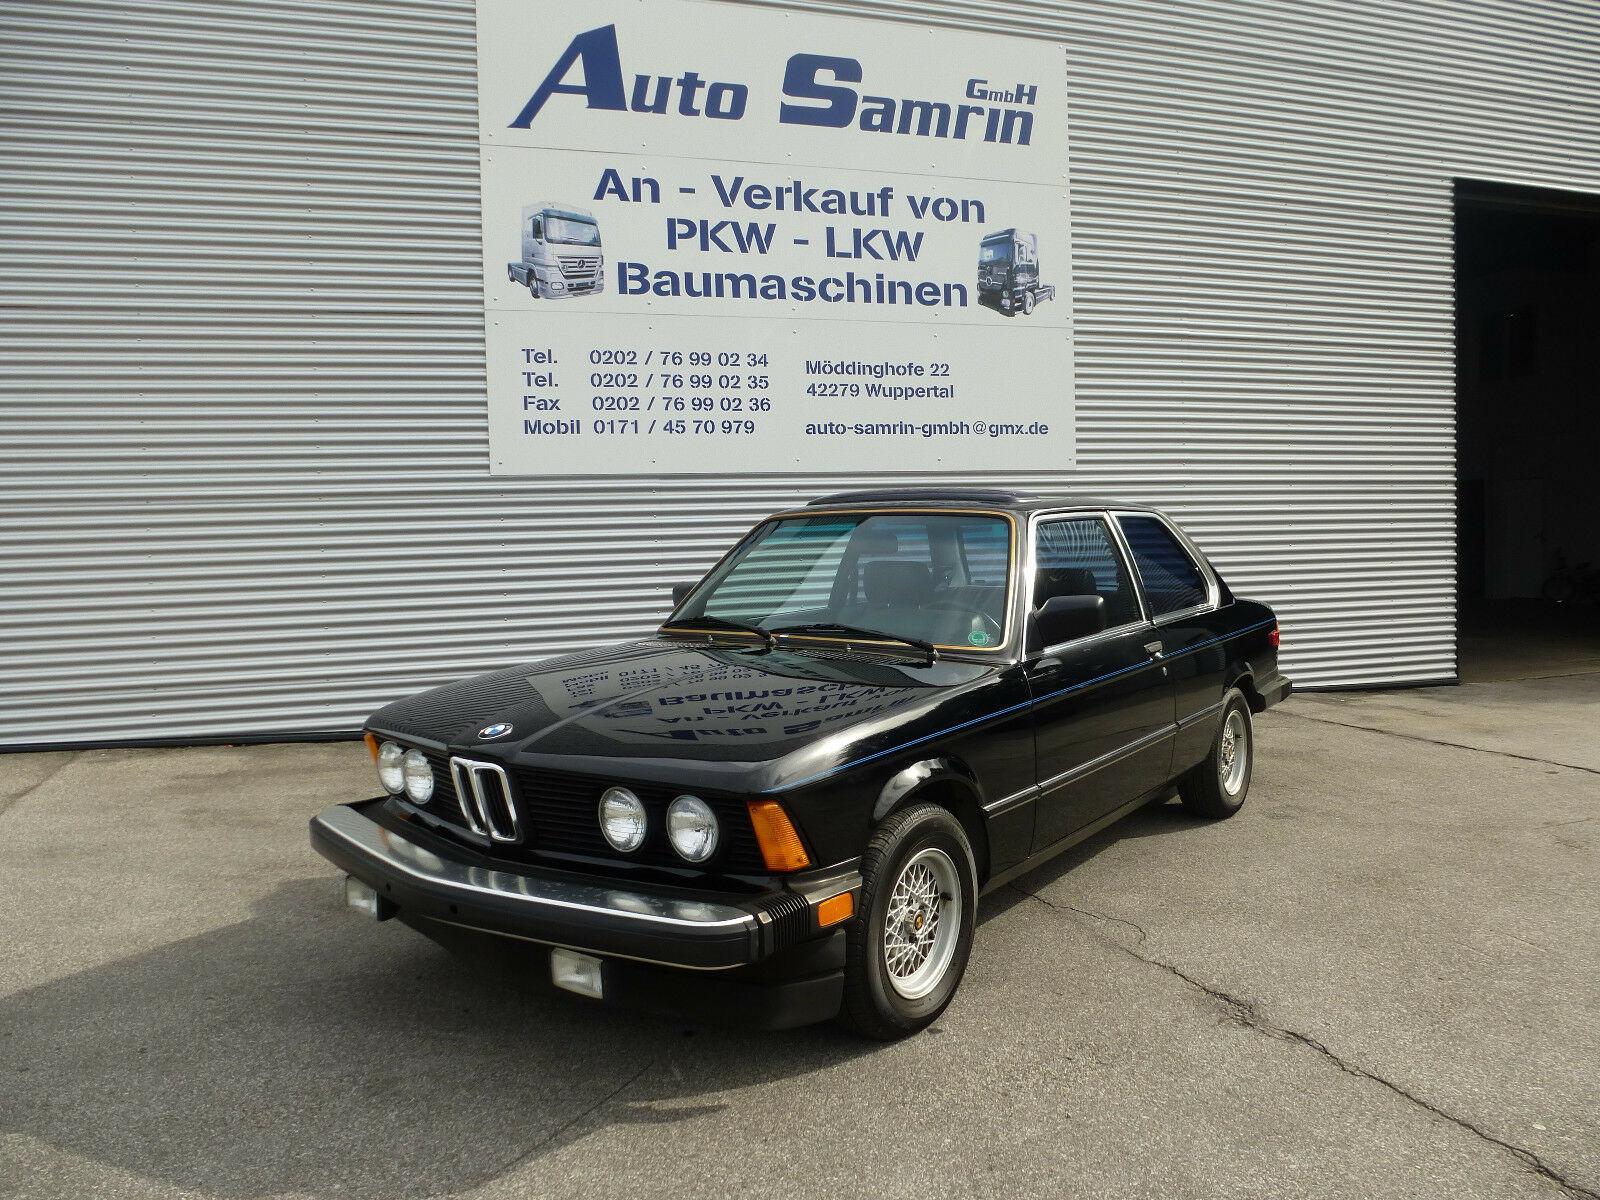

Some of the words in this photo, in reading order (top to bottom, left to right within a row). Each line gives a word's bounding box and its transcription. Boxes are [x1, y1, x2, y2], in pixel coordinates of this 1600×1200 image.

[507, 23, 749, 129] Auto
[778, 53, 1034, 146] Samrin
[965, 78, 1038, 105] GmbH
[592, 168, 661, 204] An
[711, 174, 894, 218] Verkauf
[907, 195, 986, 224] von
[666, 217, 777, 255] PKW
[793, 238, 810, 246] -
[825, 226, 925, 262] LKW
[617, 261, 968, 307] Baumaschinen
[521, 348, 558, 364] Tel.
[589, 349, 638, 365] 0202
[644, 351, 653, 366] /
[660, 351, 683, 366] 76
[688, 351, 712, 367] 99
[717, 352, 741, 367] 02
[746, 352, 769, 368] 34
[805, 360, 925, 379] Möddinghofe
[929, 362, 950, 377] 22
[521, 371, 559, 388] Tel.
[590, 372, 639, 388] 0202
[645, 373, 654, 388] /
[660, 373, 684, 389] 76
[689, 374, 713, 389] 99
[718, 374, 742, 389] 02
[747, 374, 770, 390] 35
[805, 382, 860, 398] 42279
[864, 383, 954, 401] Wuppertal
[523, 395, 562, 411] Fax
[592, 396, 640, 411] 0202
[646, 396, 656, 411] /
[662, 396, 686, 411] 76
[691, 396, 714, 412] 99
[720, 397, 743, 412] 02
[748, 397, 771, 412] 36
[523, 419, 581, 435] Mobil
[593, 419, 639, 434] 0171
[648, 419, 657, 434] /
[662, 419, 687, 434] 45
[692, 419, 716, 435] 70
[721, 419, 755, 435] 979
[805, 420, 1049, 438] auto-samrin-gmbh@gmx.de
